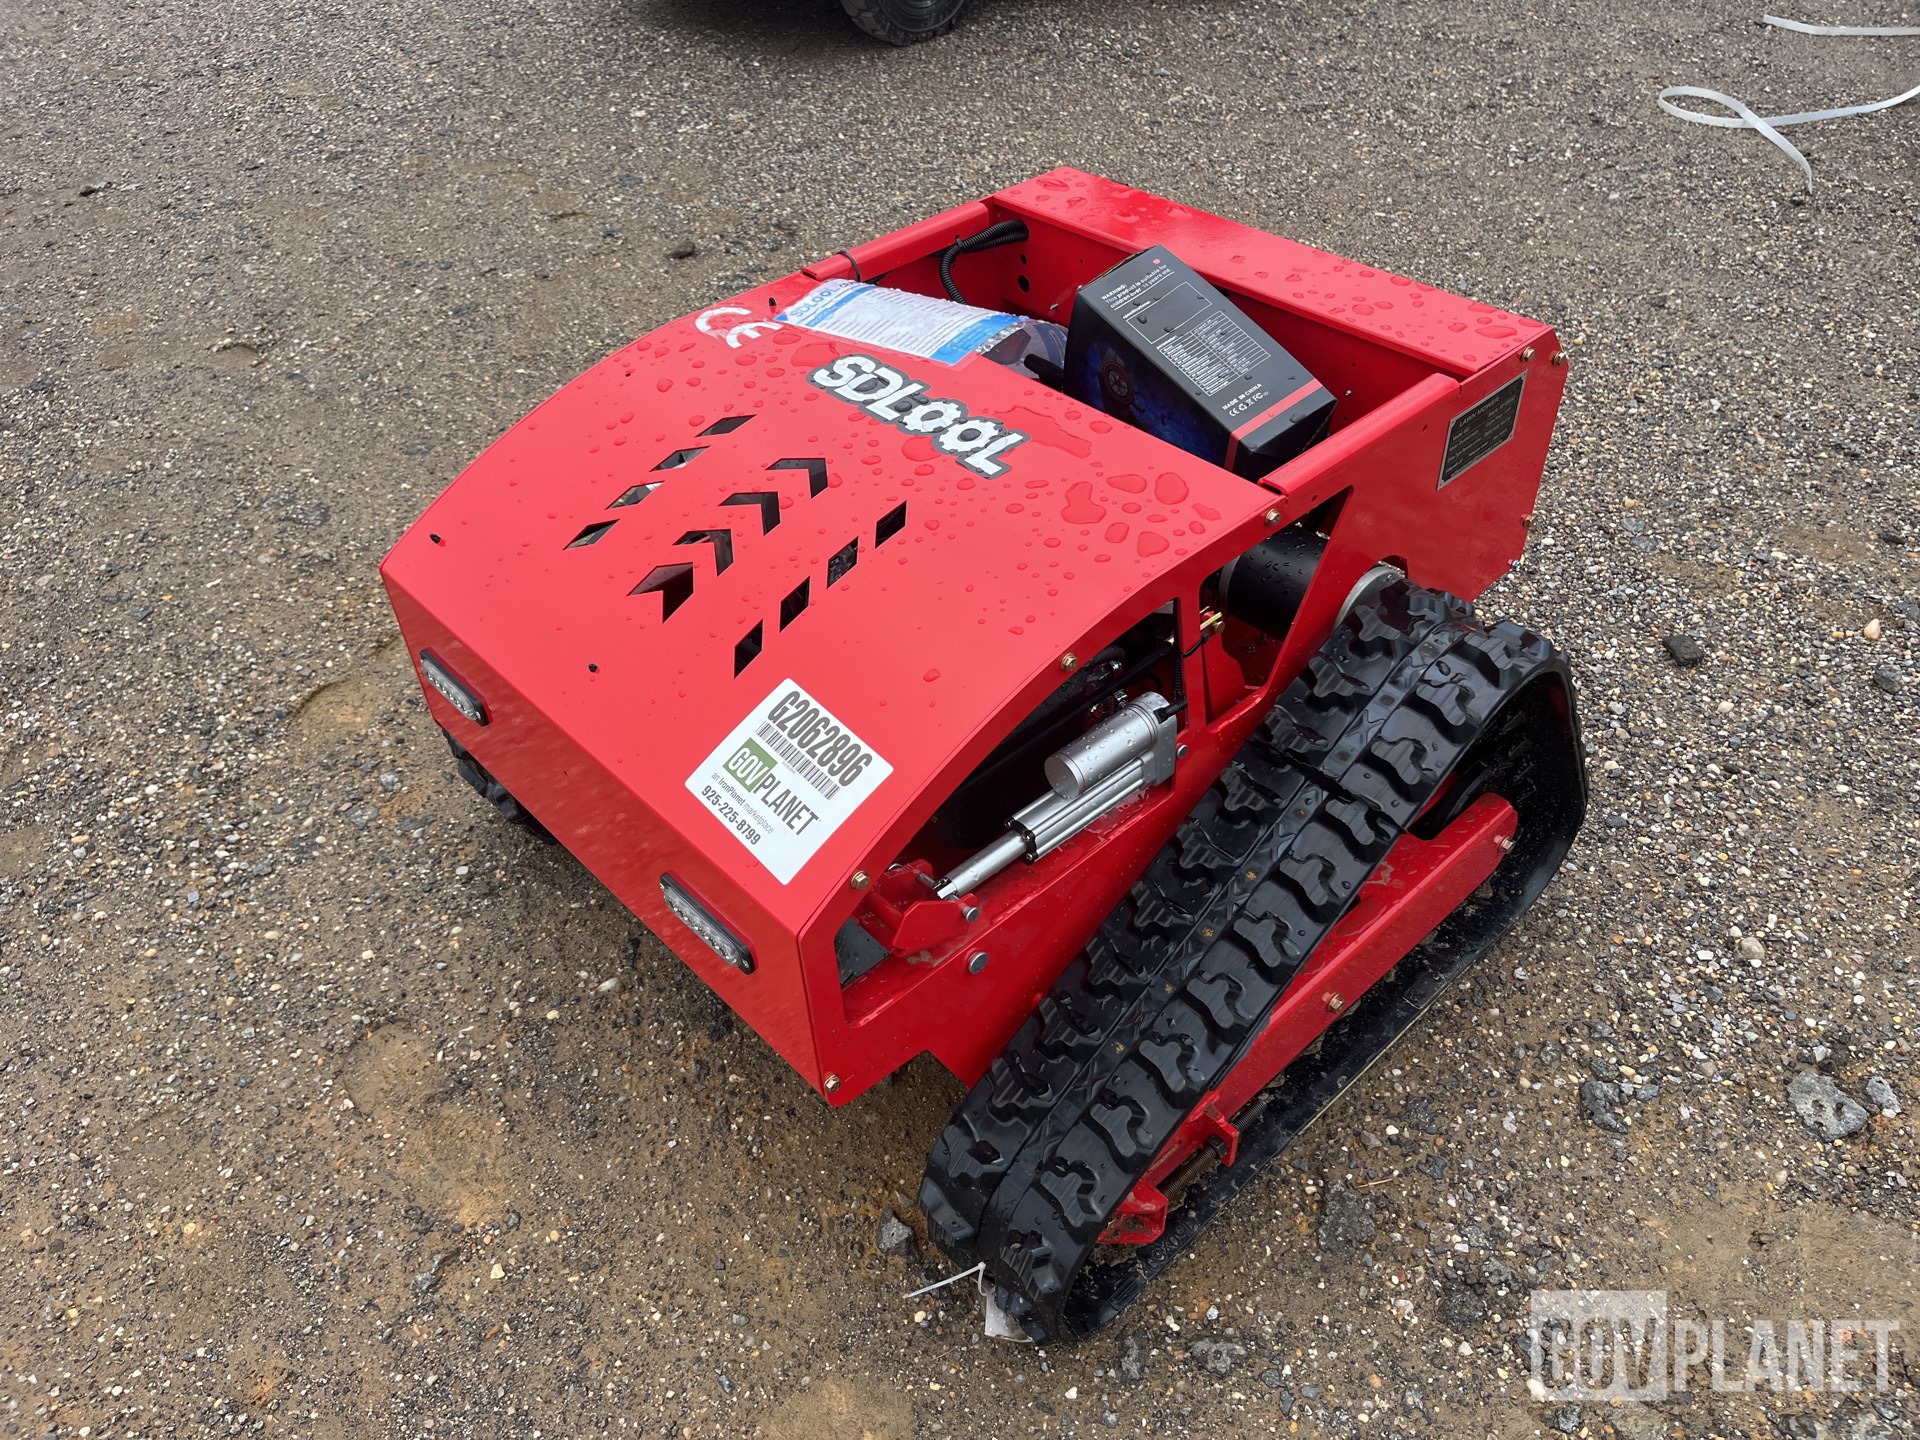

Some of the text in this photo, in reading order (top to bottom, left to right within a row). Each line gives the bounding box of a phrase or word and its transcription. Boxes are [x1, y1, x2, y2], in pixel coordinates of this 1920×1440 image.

[812, 355, 1025, 476] SDLOOL
[1221, 398, 1239, 411] MADE
[1244, 383, 1263, 396] CHINA
[767, 690, 873, 787] G2062896
[701, 785, 761, 845] 925-225-8799
[711, 772, 775, 834] an IronPlanet marketplace
